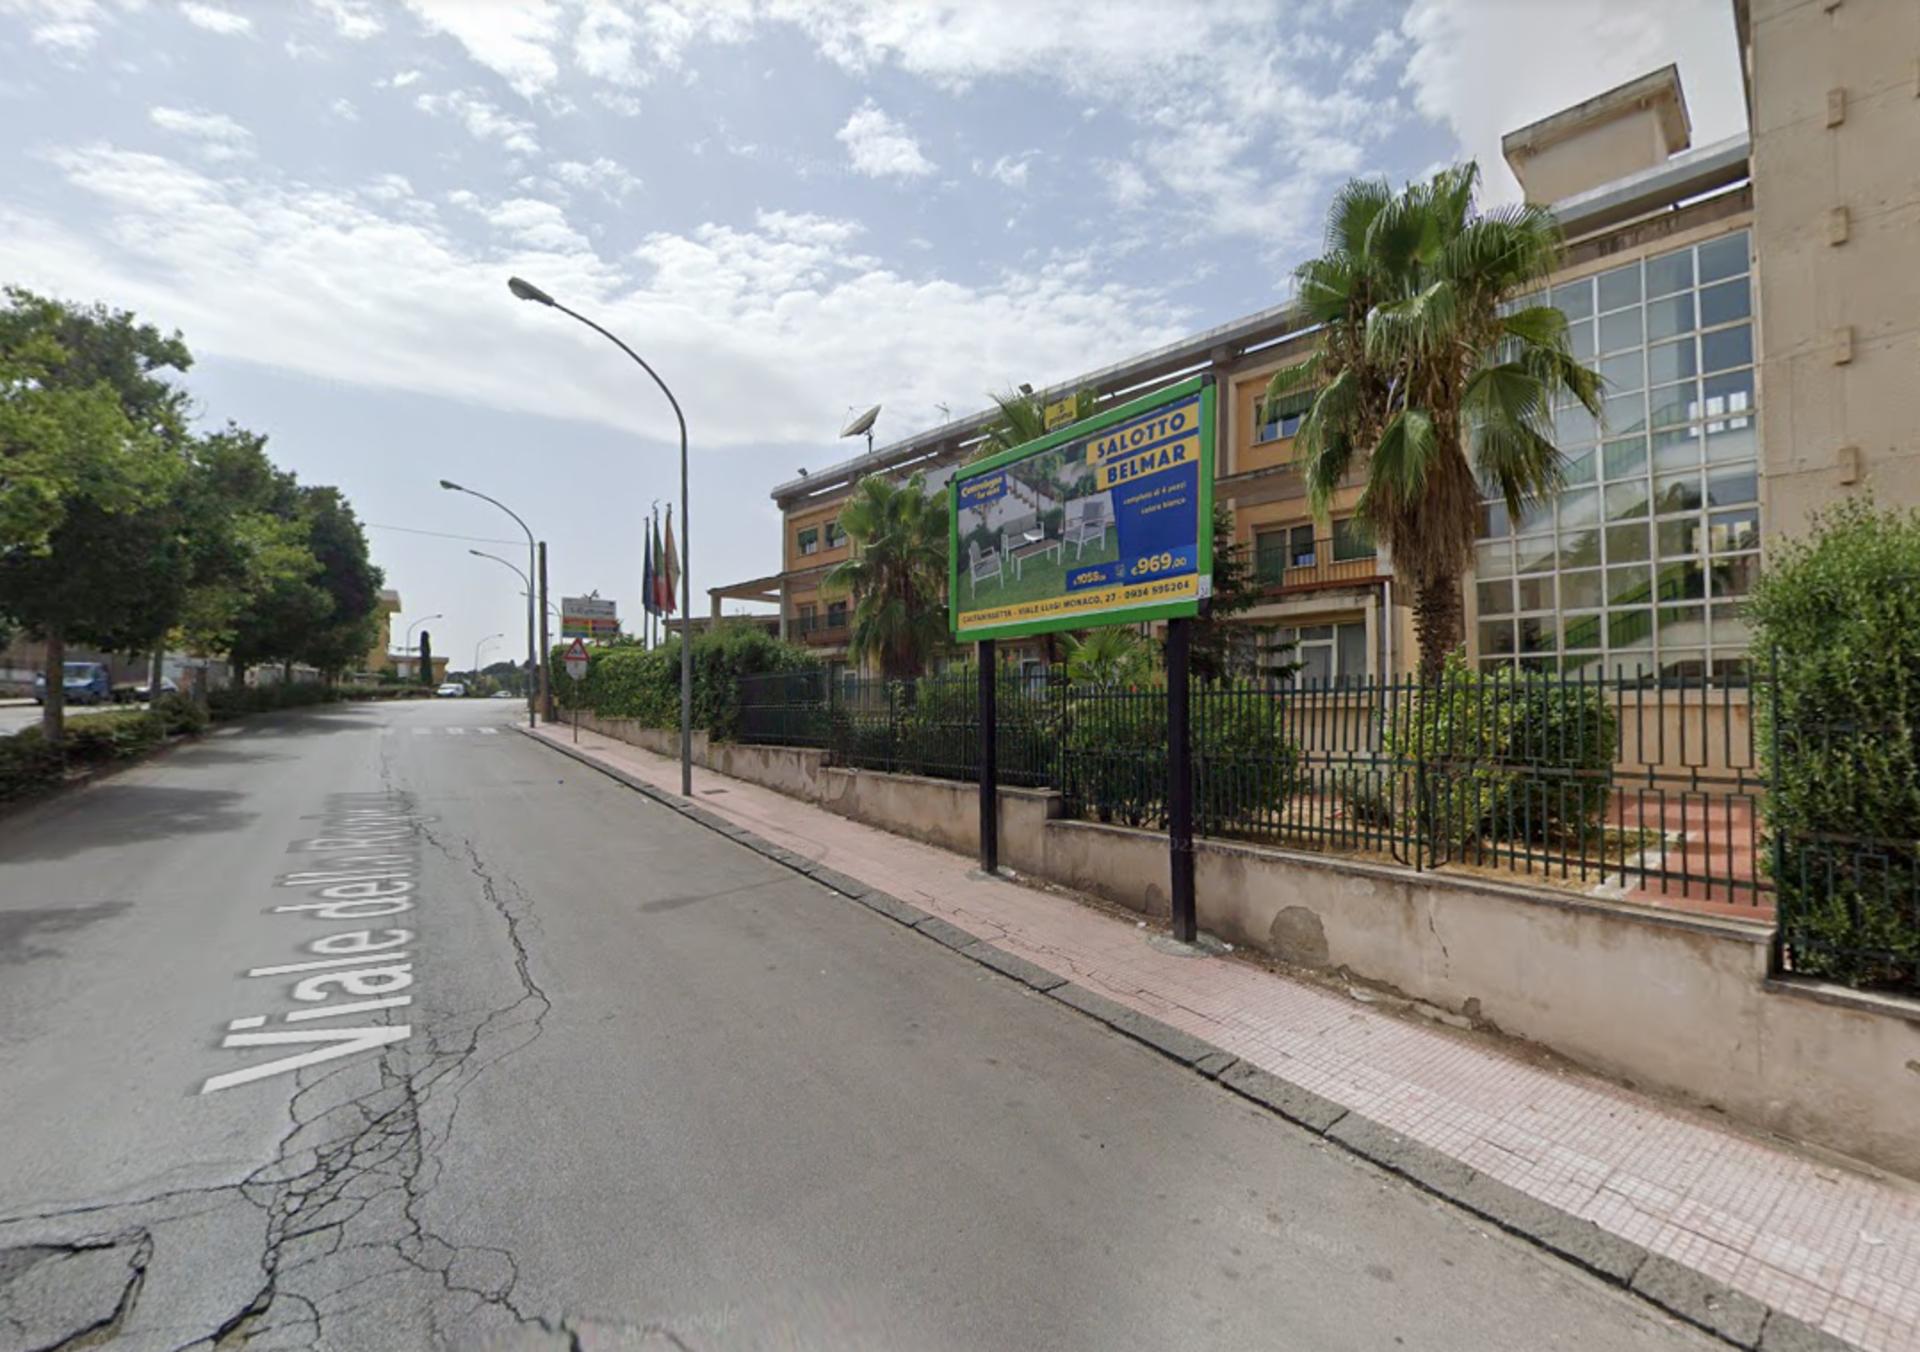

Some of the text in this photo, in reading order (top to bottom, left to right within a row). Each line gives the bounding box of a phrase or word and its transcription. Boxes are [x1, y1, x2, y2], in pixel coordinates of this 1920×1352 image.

[1097, 412, 1186, 459] SALOTTO
[1107, 443, 1186, 484] BELMAR
[1018, 604, 1039, 616] VIALE
[1105, 593, 1116, 602] 27
